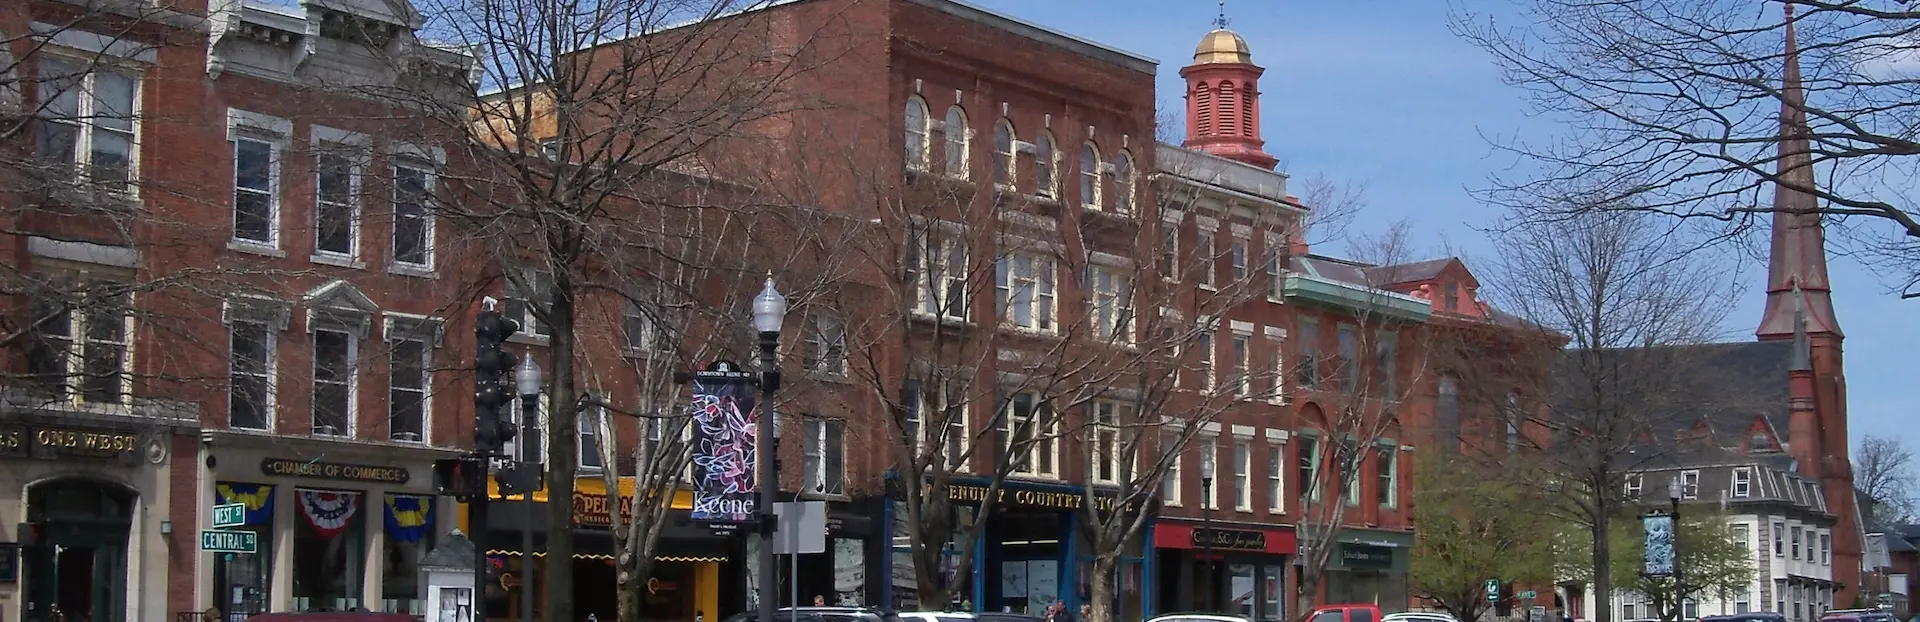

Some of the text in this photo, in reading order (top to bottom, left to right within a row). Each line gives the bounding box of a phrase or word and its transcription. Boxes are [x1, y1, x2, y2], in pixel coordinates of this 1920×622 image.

[38, 430, 77, 447] ONE
[82, 432, 137, 452] WEST
[273, 461, 400, 481] CHAMBER OF COMMERCE
[693, 490, 754, 515] Keene
[1015, 490, 1082, 509] COUNTRY
[214, 507, 232, 525] WEST
[203, 532, 245, 550] CENTRAL
